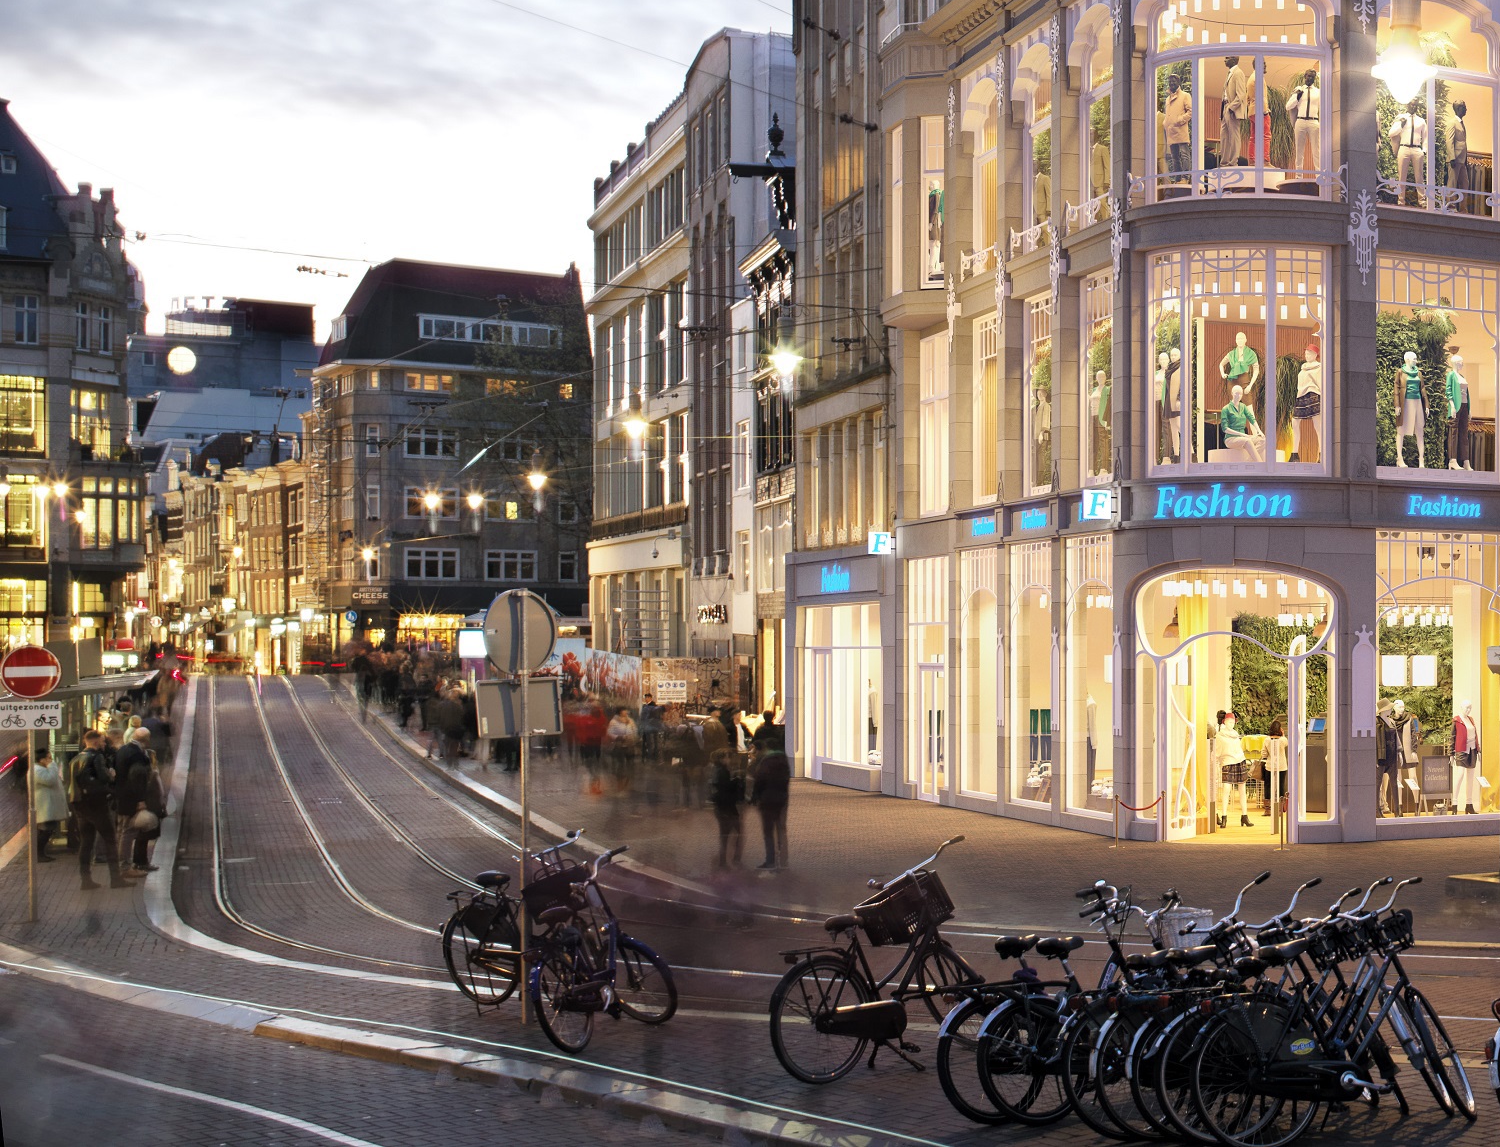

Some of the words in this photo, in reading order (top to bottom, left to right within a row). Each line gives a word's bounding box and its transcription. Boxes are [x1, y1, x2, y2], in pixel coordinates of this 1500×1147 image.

[1087, 492, 1107, 516] F
[1153, 483, 1293, 519] Fashion
[1408, 495, 1482, 518] Fashion
[871, 533, 887, 553] F
[0, 703, 59, 712] uitgezonderd
